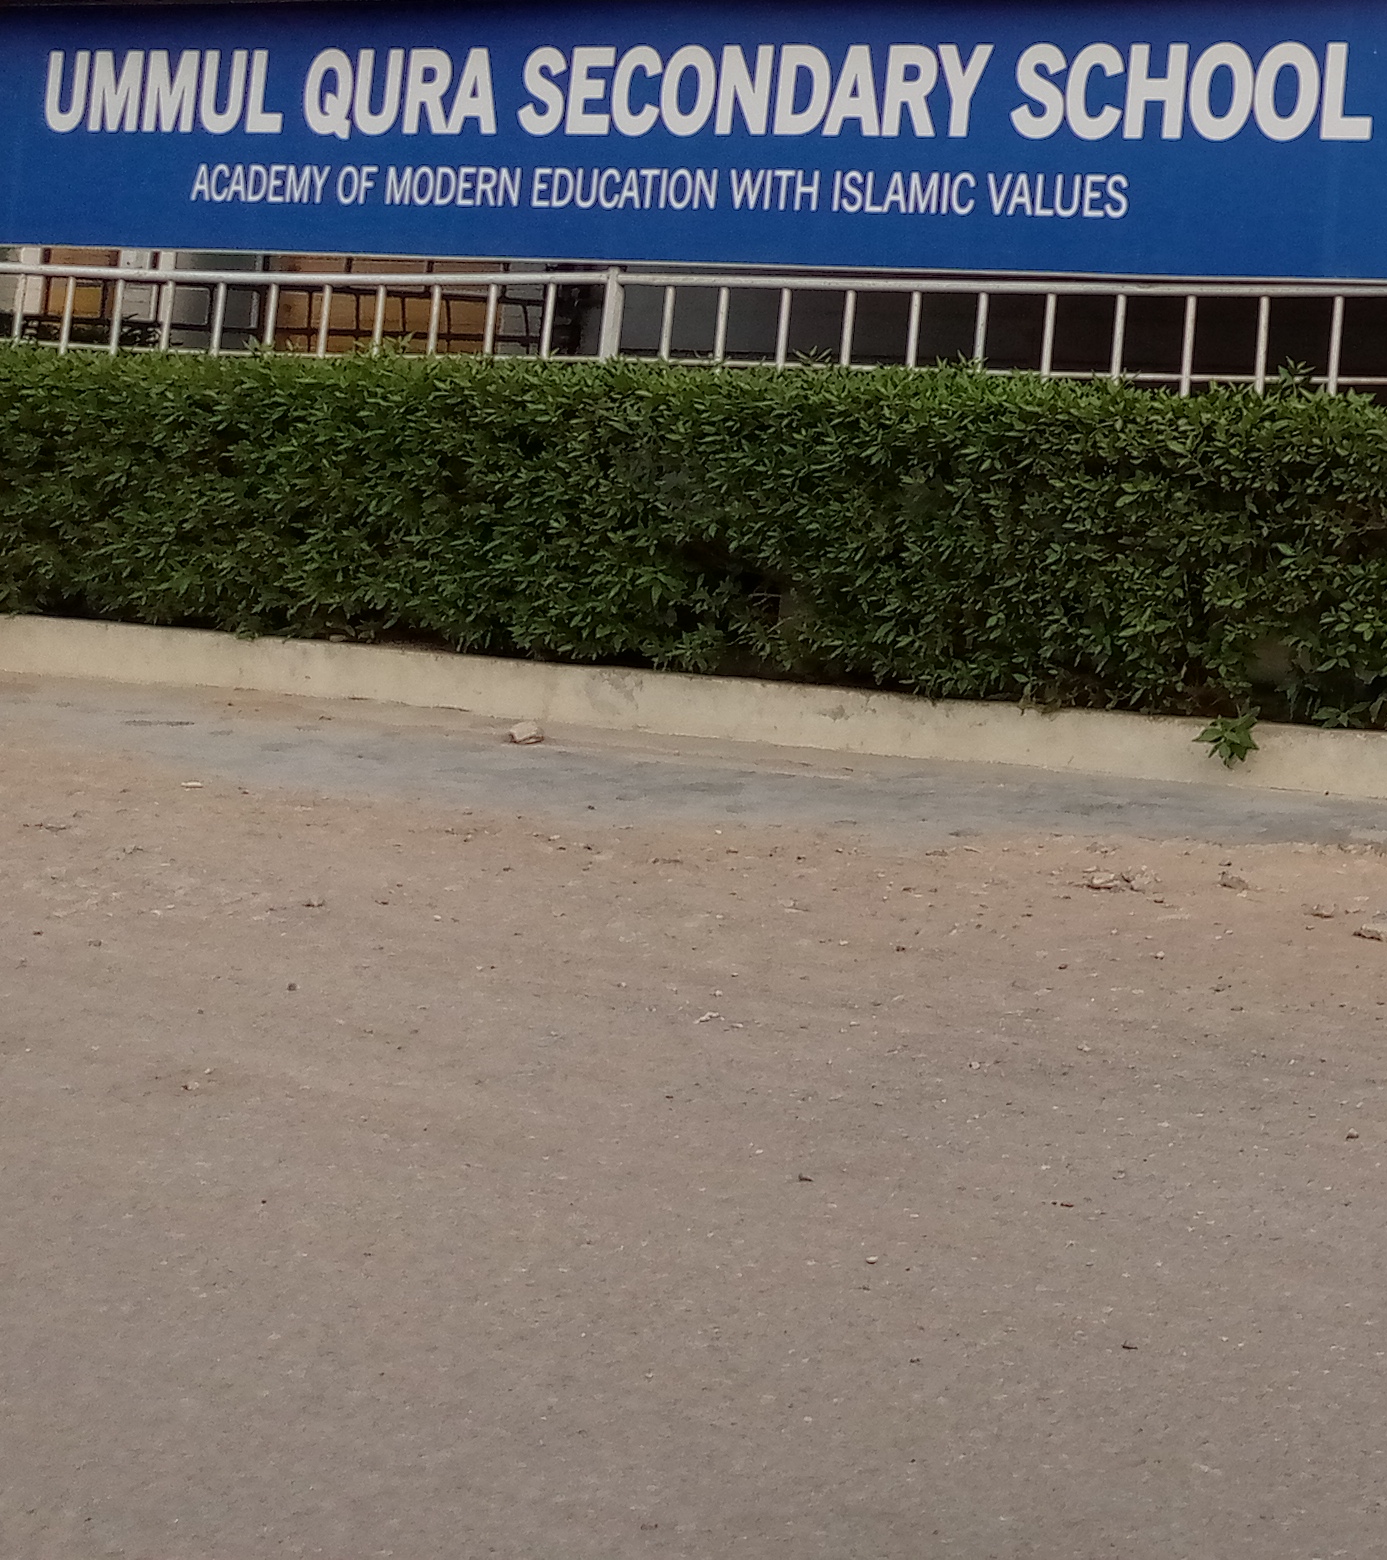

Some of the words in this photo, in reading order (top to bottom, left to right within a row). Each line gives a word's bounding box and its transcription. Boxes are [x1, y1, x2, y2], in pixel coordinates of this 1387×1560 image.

[44, 49, 283, 134] UMMUL
[303, 47, 497, 140] QURA
[517, 44, 994, 137] SECONDARY
[1010, 41, 1373, 141] SCHOOL
[191, 163, 331, 203] ACADEMY
[337, 165, 378, 205] OF
[385, 166, 521, 207] MODERN
[531, 167, 718, 210] EDUCATION
[730, 169, 820, 211] WITH
[832, 170, 976, 215] ISLAMIC
[988, 173, 1128, 218] VALUES
